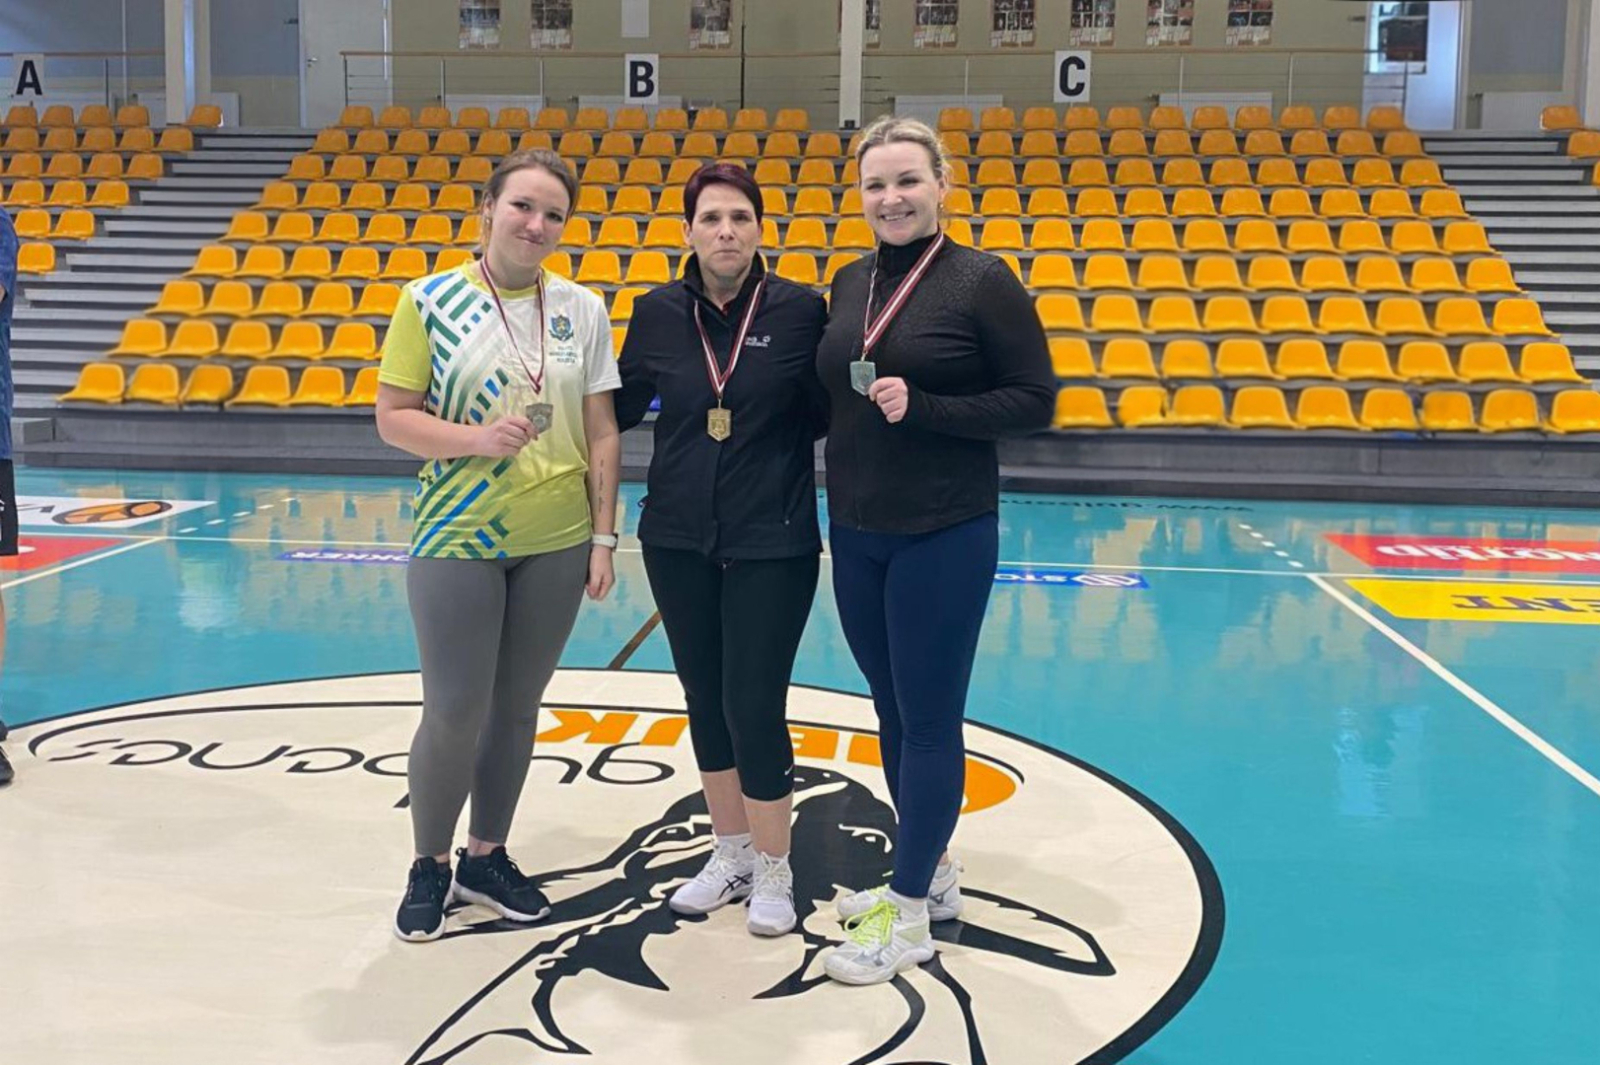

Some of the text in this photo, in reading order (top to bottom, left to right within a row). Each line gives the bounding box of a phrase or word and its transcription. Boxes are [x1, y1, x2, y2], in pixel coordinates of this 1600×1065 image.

[16, 60, 43, 96] A
[629, 61, 654, 97] B
[1059, 55, 1087, 98] C
[48, 738, 676, 809] gubenes
